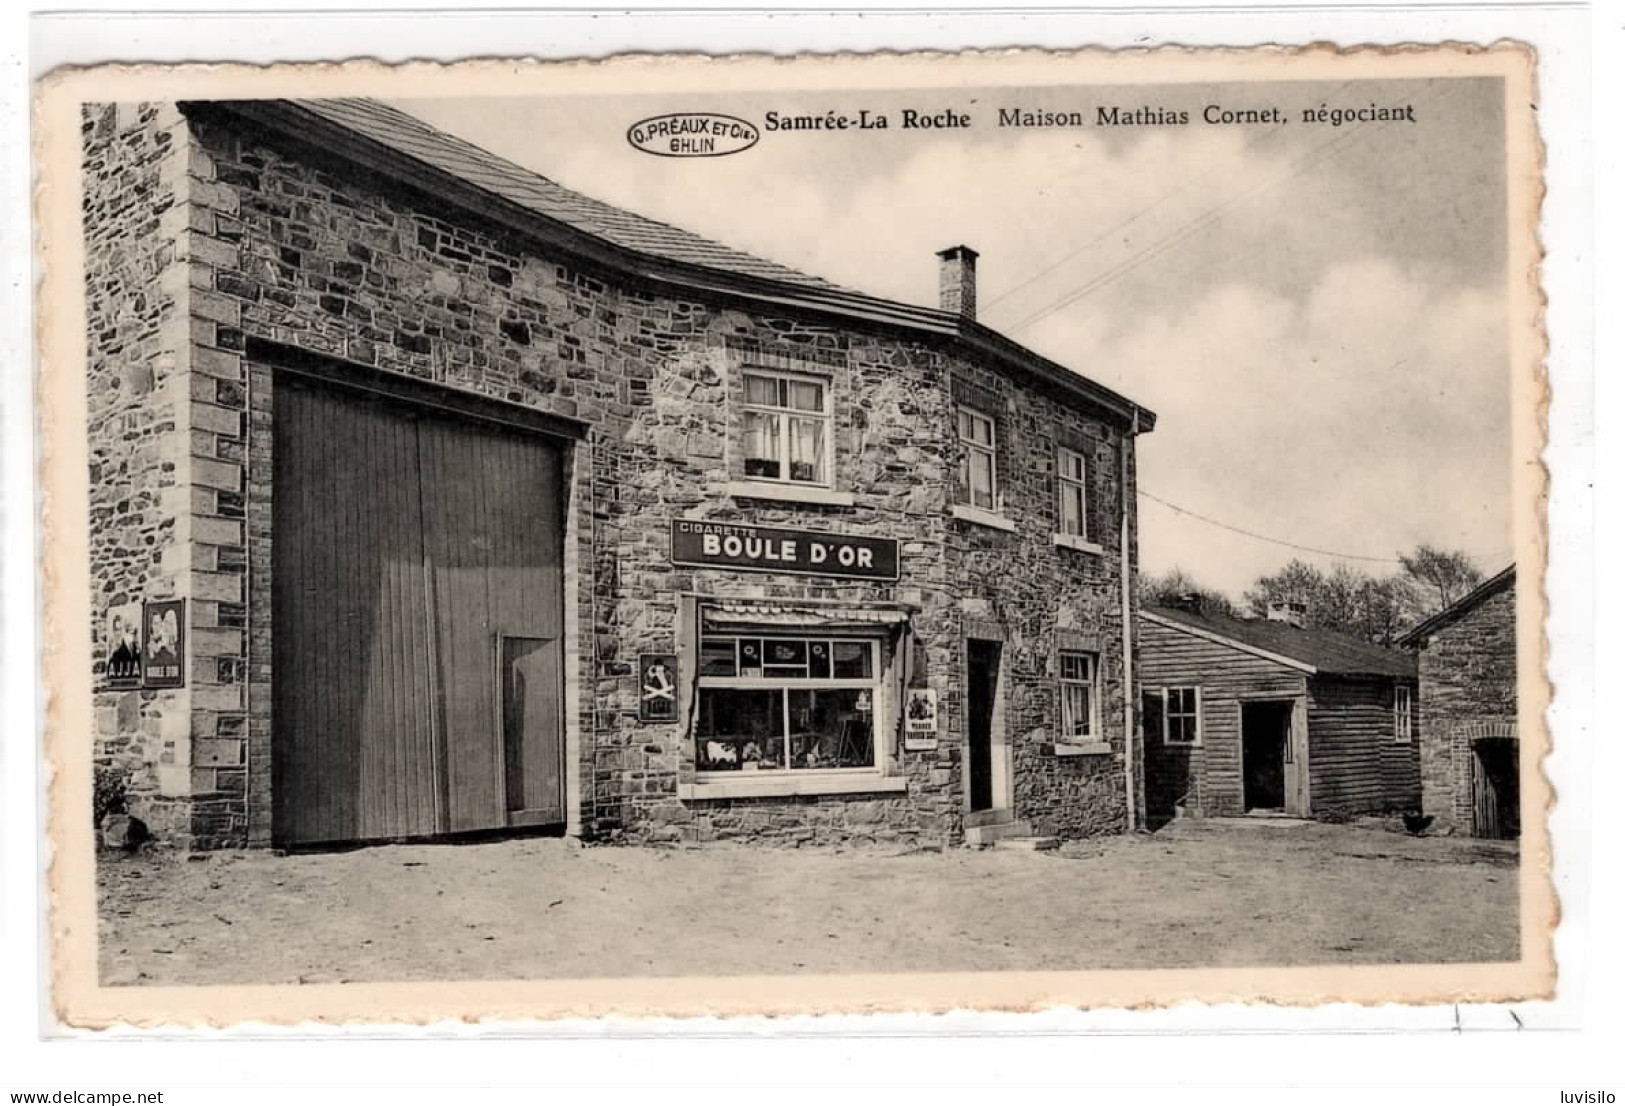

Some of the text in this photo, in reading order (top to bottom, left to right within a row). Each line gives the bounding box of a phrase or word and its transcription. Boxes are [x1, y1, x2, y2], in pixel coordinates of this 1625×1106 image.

[680, 523, 756, 537] CIGARETTE
[703, 534, 872, 568] BOULE D'OR
